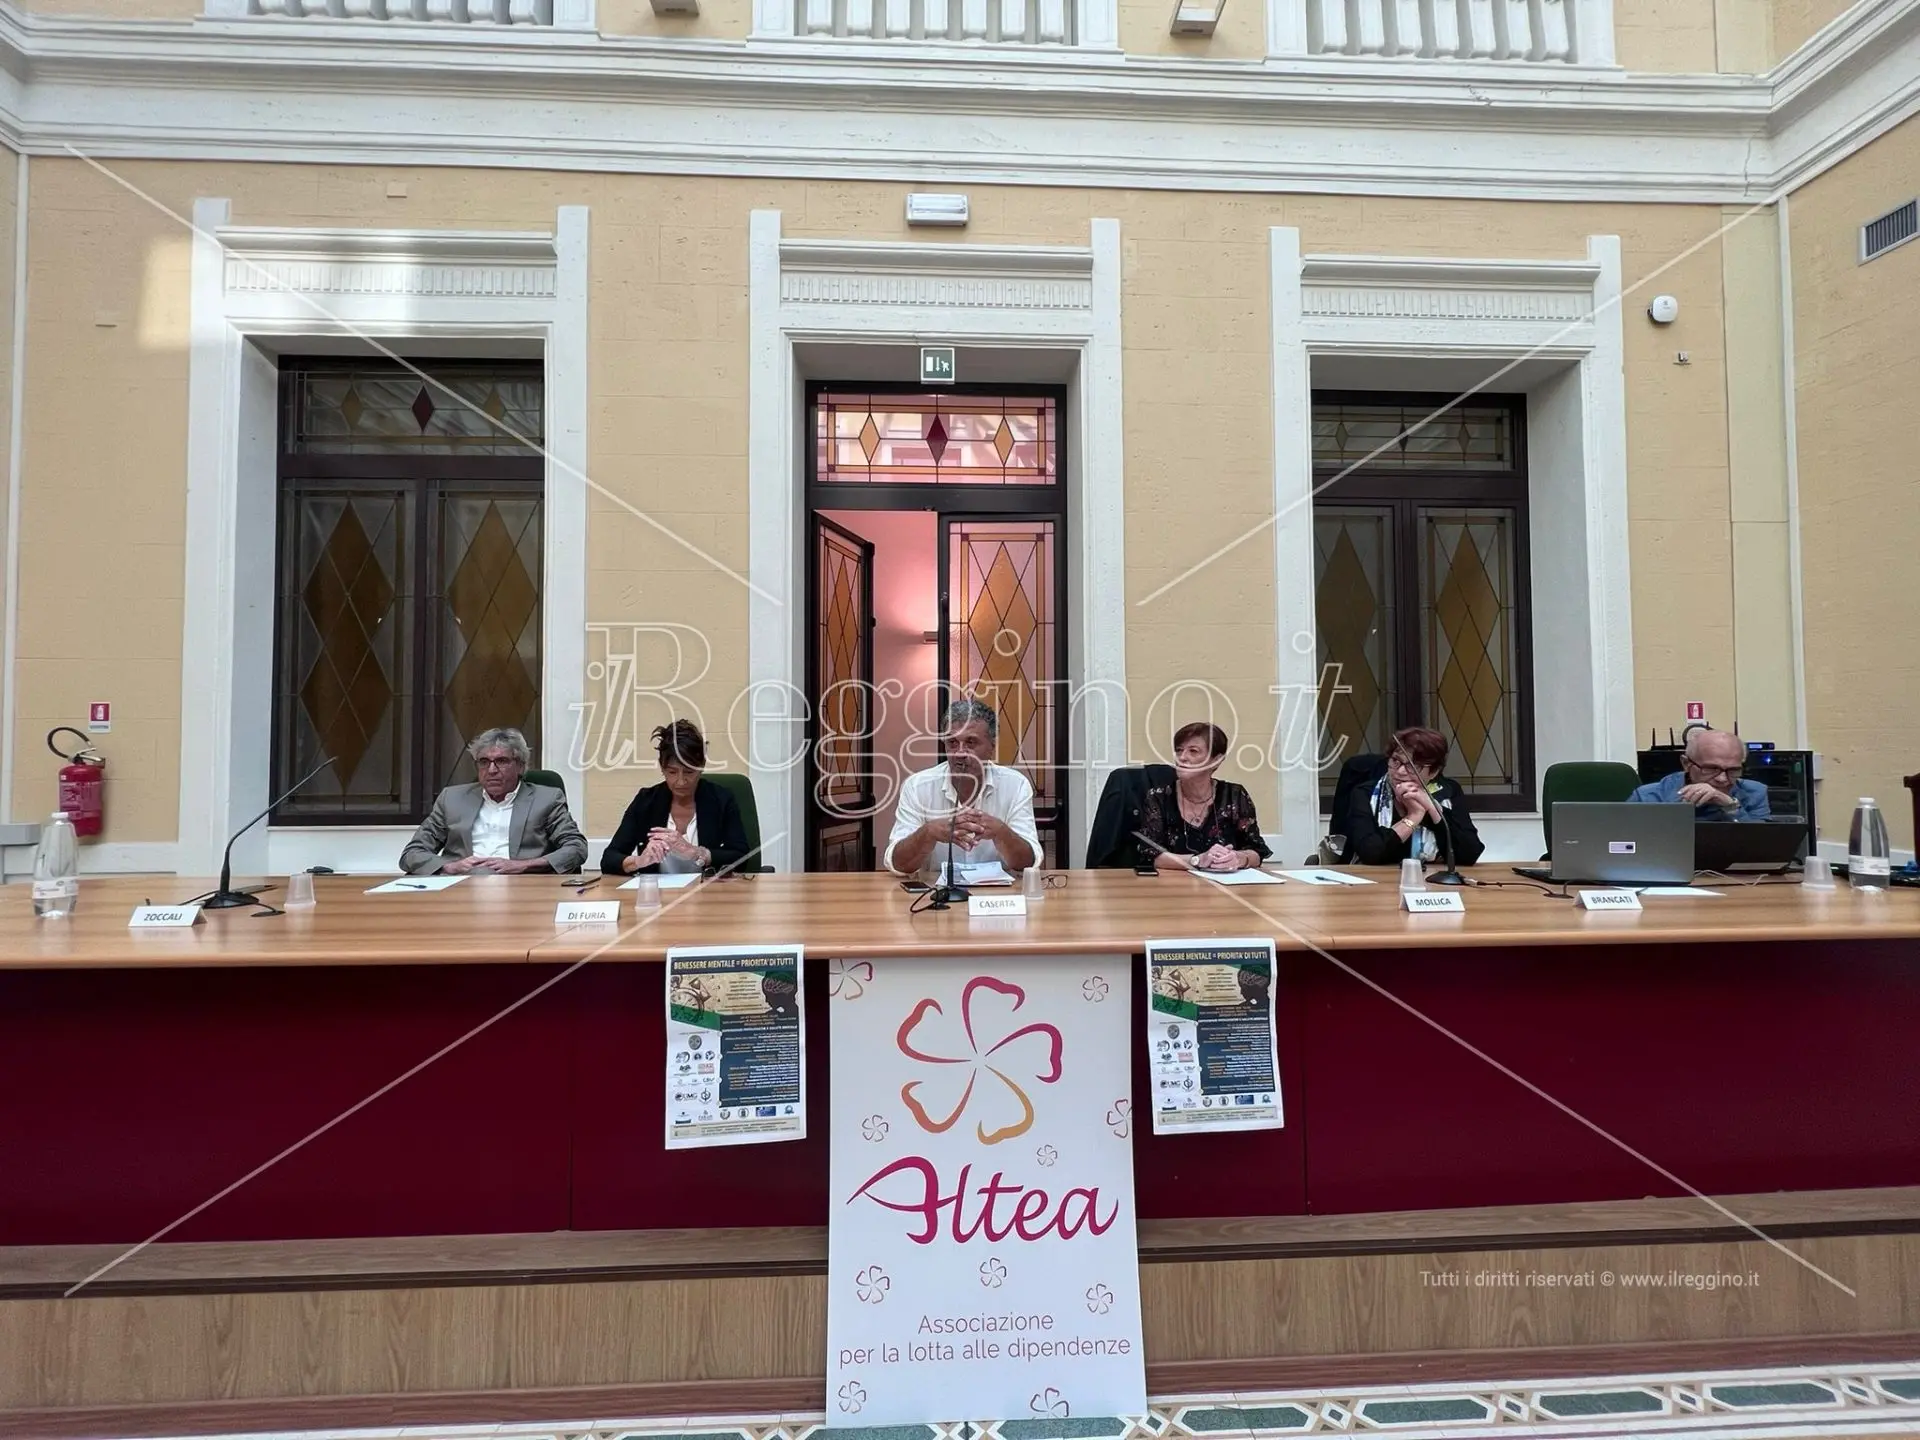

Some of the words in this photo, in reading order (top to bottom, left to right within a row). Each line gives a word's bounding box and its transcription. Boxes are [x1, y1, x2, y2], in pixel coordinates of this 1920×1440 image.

[979, 899, 1016, 909] CASERTA
[1415, 897, 1452, 907] MOLLICA
[1591, 896, 1633, 905] BRANCATI
[143, 912, 183, 922] ZOCCALI
[567, 911, 578, 921] DI
[579, 910, 607, 920] FURIA
[673, 960, 707, 970] BENESSERE
[708, 960, 735, 969] MENTALE
[777, 957, 794, 966] TUTTI
[846, 1155, 1120, 1245] Altea
[917, 1312, 1054, 1335] Associazione
[839, 1347, 875, 1370] per
[882, 1342, 900, 1363] la
[908, 1340, 955, 1362] lotta
[962, 1338, 1000, 1360] alle
[1007, 1335, 1131, 1362] dipendenze
